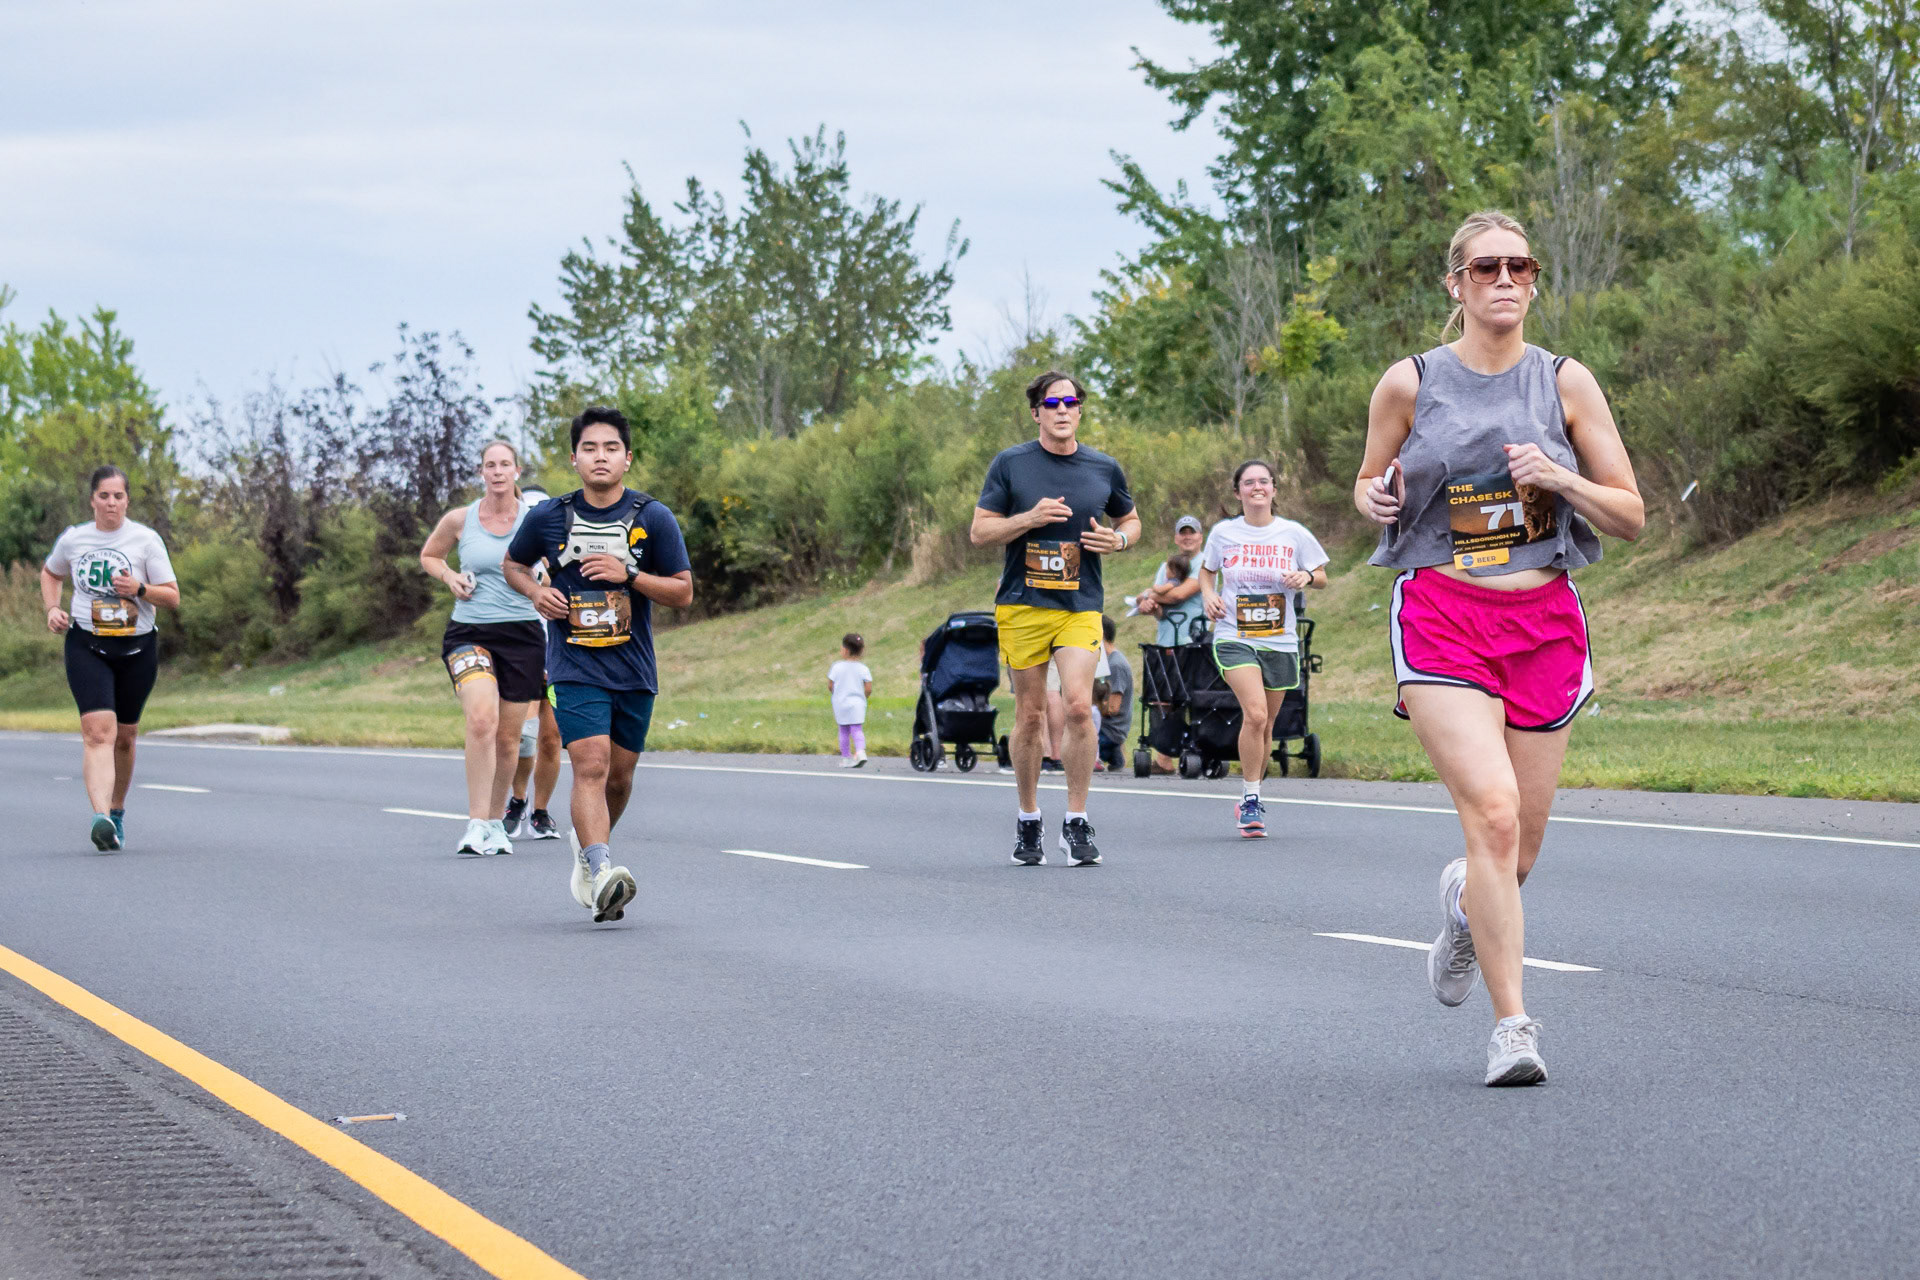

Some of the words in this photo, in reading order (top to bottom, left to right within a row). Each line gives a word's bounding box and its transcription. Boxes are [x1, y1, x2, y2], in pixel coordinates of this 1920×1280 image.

[1448, 484, 1474, 493] THE
[1450, 494, 1493, 504] CHASE
[1495, 491, 1512, 500] 5K
[1480, 501, 1525, 530] 71
[1455, 535, 1509, 545] HILLSBOROUGH
[1243, 544, 1278, 555] STRIDE
[1282, 546, 1294, 558] TO
[1039, 556, 1066, 571] 10
[1242, 556, 1291, 571] PROVIDE
[1477, 555, 1497, 564] BEER
[580, 609, 618, 627] 64
[1242, 607, 1281, 622] 162
